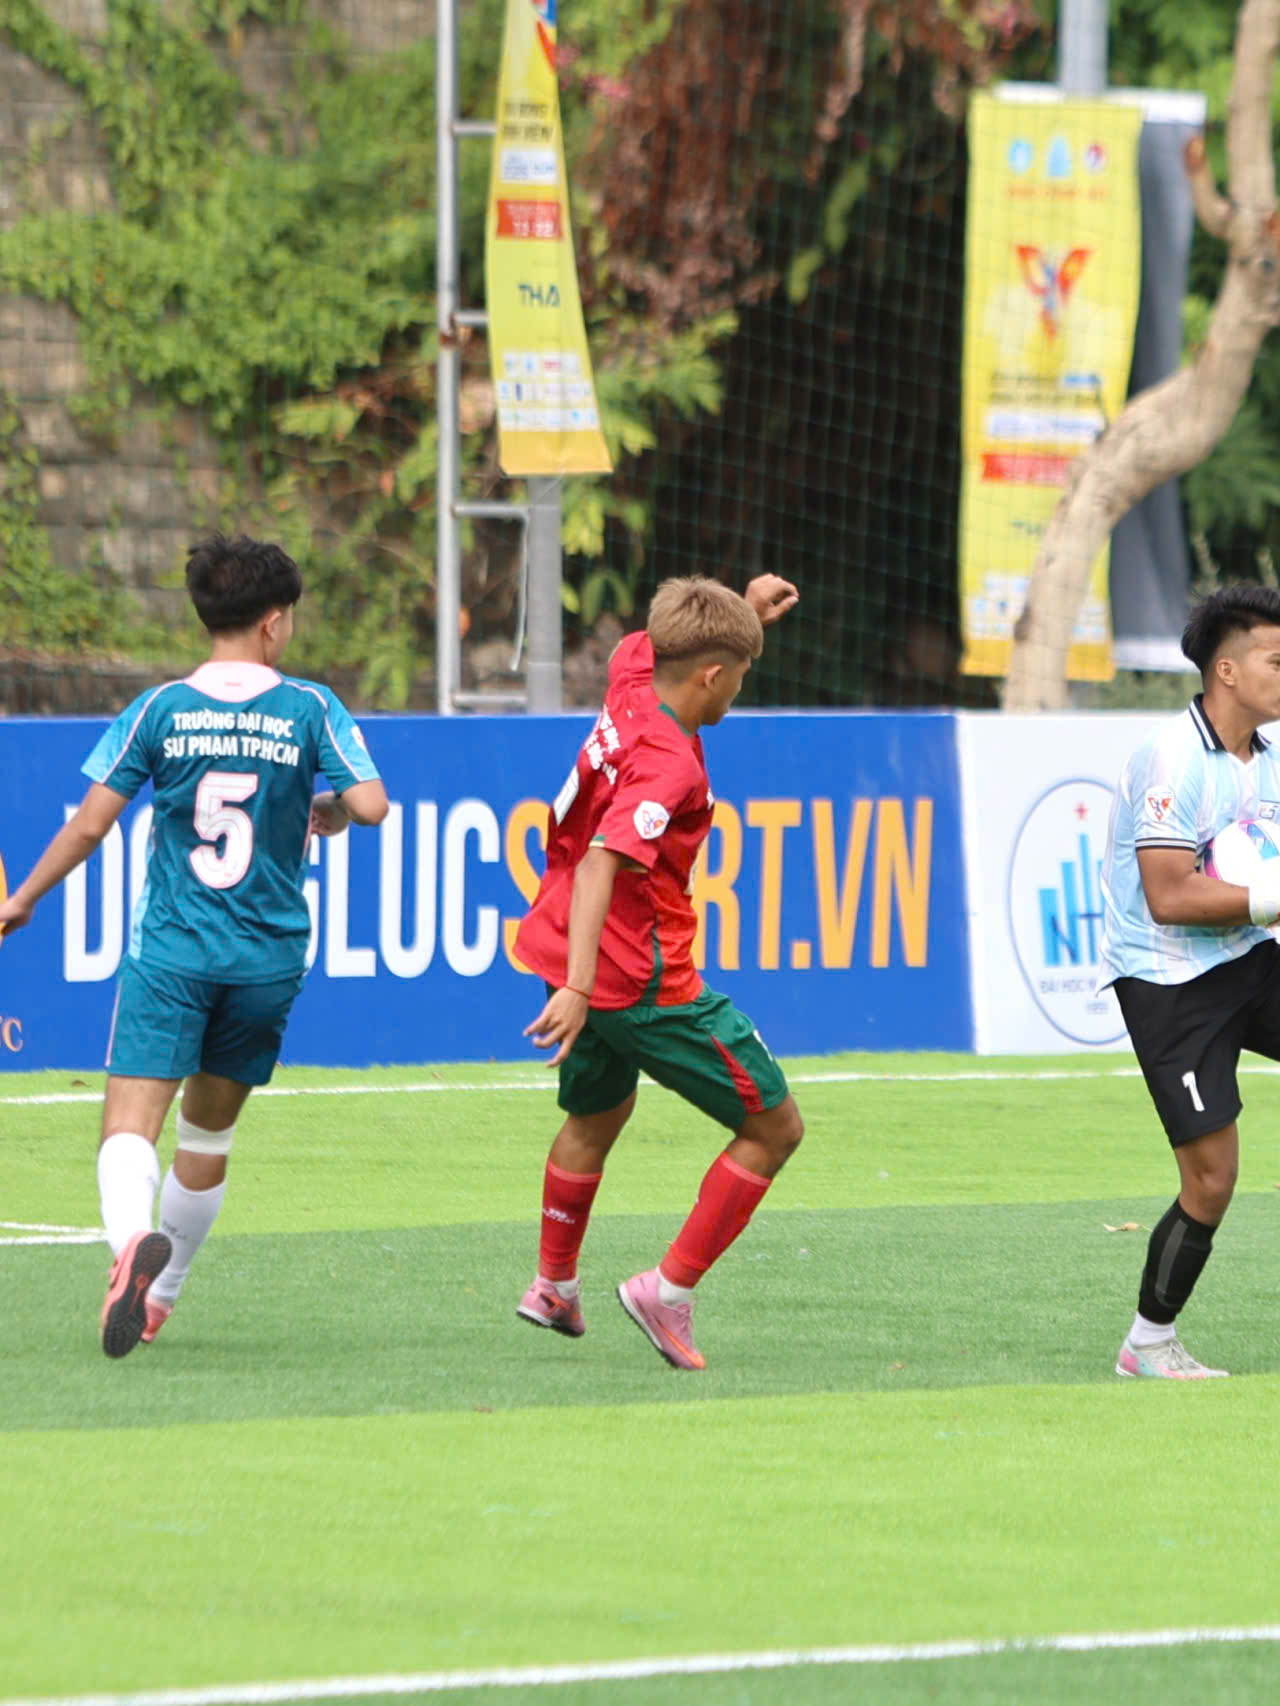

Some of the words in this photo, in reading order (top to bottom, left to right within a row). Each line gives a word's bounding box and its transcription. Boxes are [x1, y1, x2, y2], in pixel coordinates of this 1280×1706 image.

[237, 712, 261, 734] ĐẠI
[262, 715, 294, 739] HỌC
[163, 736, 187, 759] SƯ
[188, 736, 238, 760] PHẠM
[189, 771, 258, 889] 5
[1182, 1071, 1205, 1112] 1
